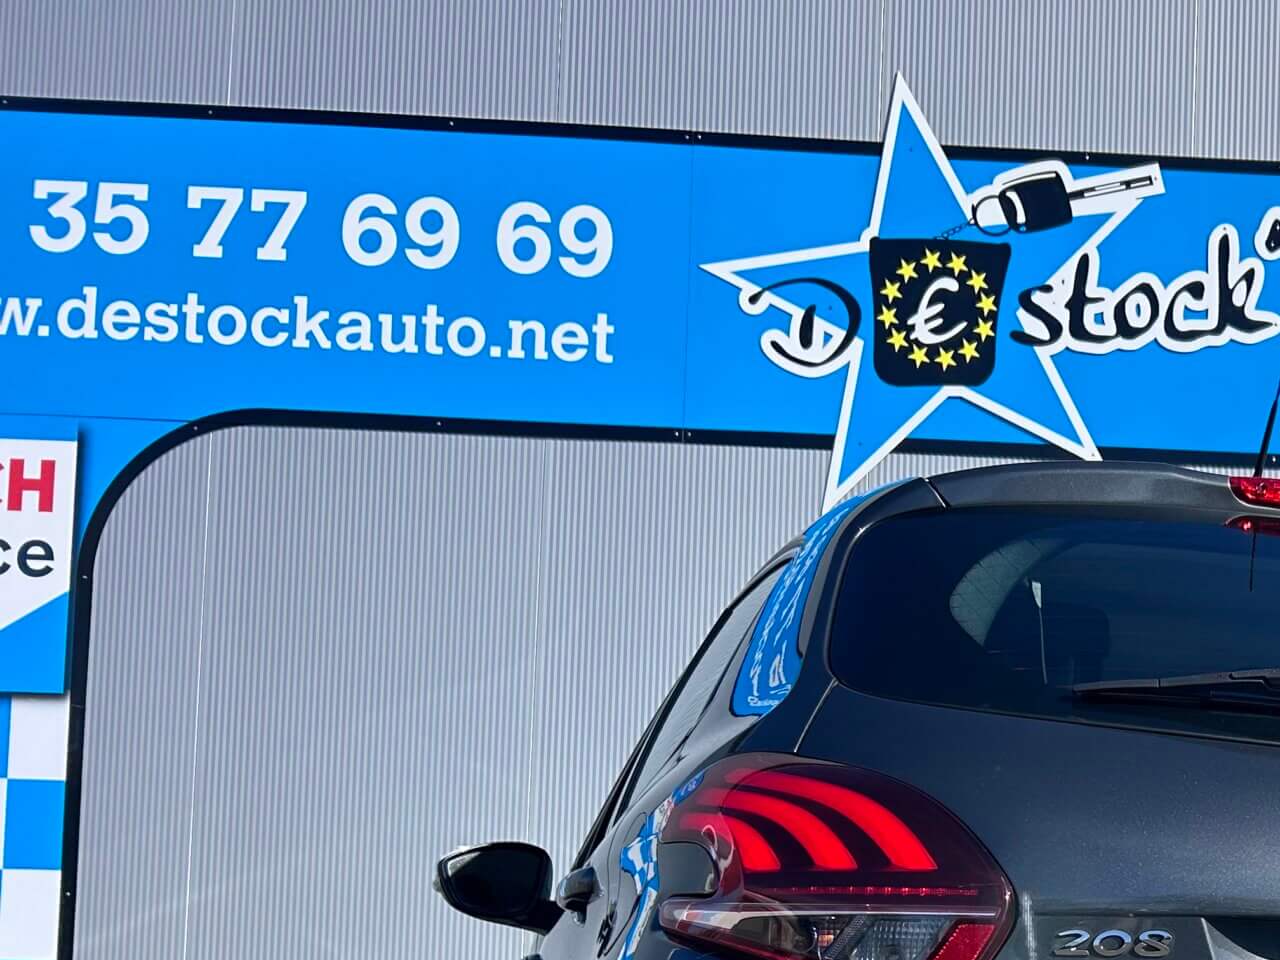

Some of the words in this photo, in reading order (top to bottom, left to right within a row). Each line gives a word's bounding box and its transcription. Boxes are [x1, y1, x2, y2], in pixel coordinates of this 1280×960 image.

[29, 179, 149, 255] 35
[187, 186, 308, 261] 77
[342, 193, 460, 270] 69
[496, 201, 614, 278] 69
[1054, 929, 1173, 957] 208
